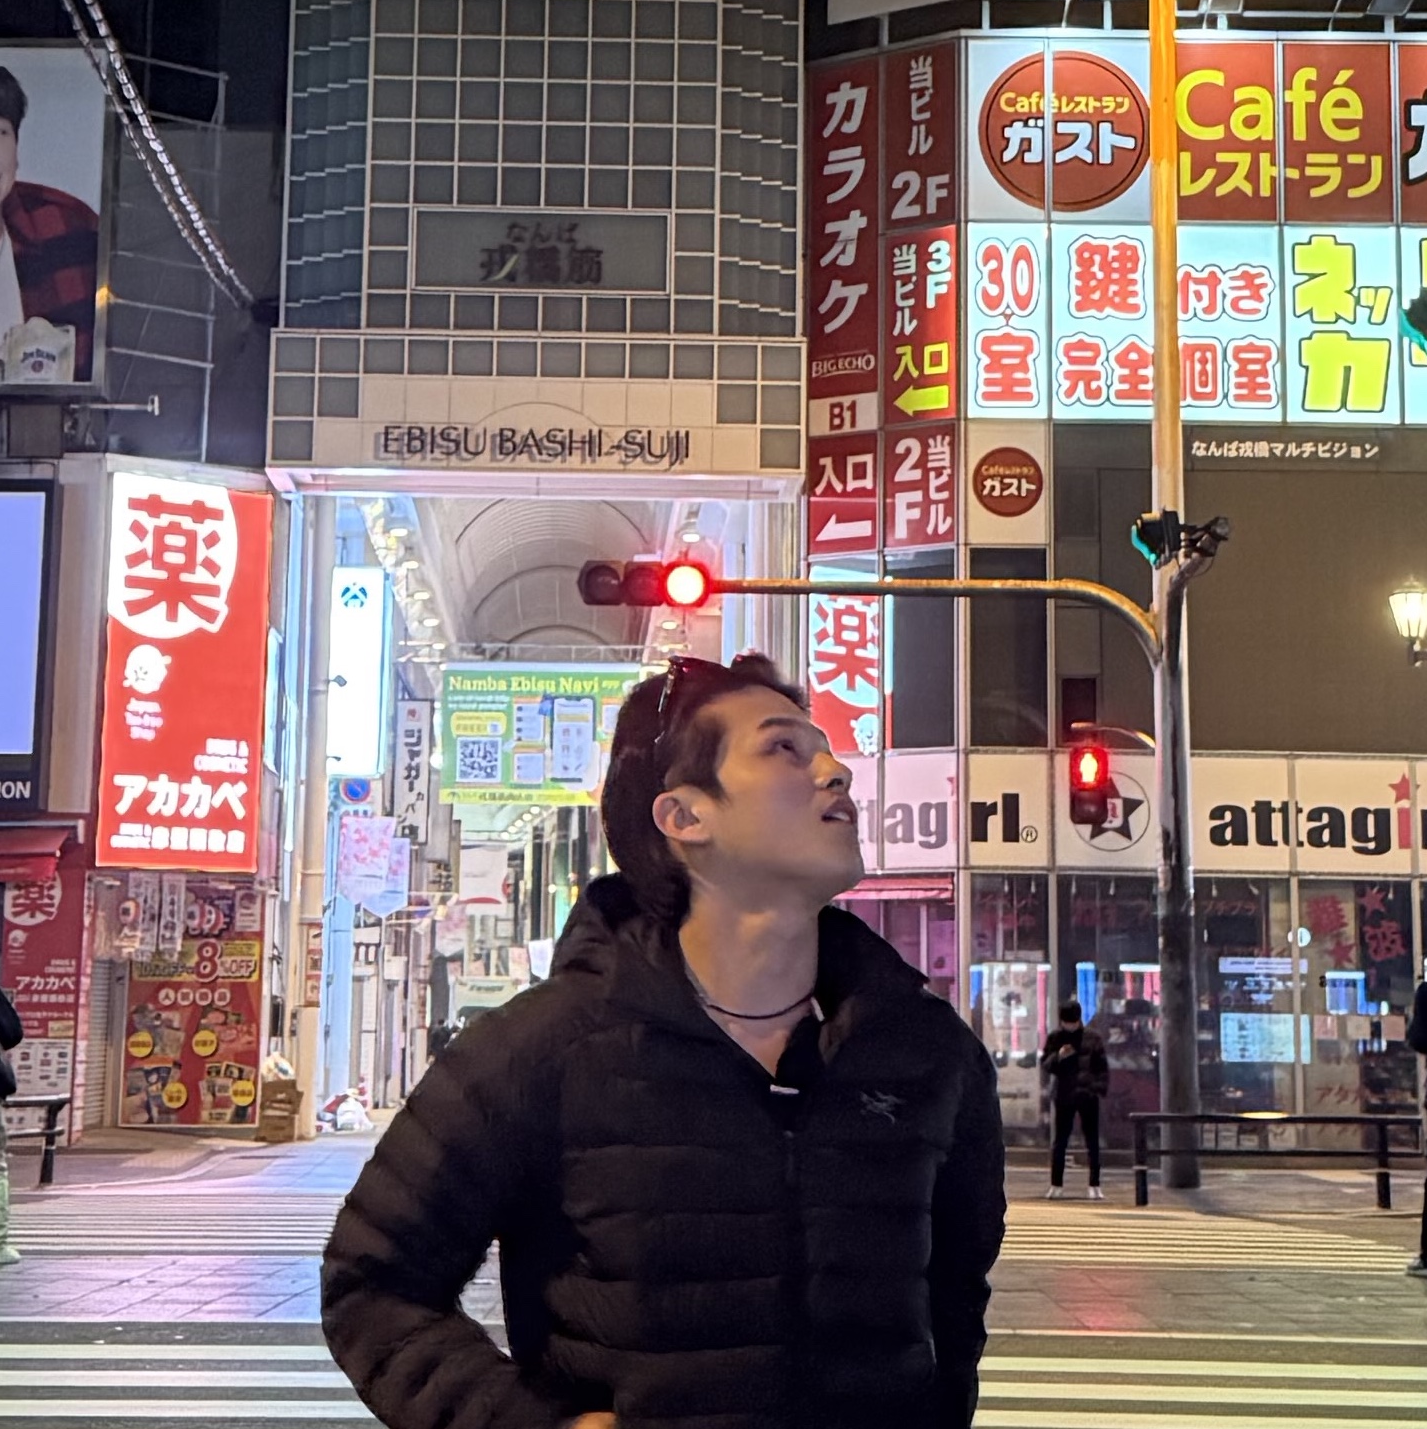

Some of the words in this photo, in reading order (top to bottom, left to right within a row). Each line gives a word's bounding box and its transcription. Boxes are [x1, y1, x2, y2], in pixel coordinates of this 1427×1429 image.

[909, 55, 934, 156] 当ビル
[1174, 67, 1365, 141] Café
[1002, 117, 1137, 165] ガスト
[891, 171, 950, 220] 2F
[1179, 152, 1383, 199] レストラン
[818, 81, 869, 334] カラオケ
[892, 245, 917, 336] 当ビル
[981, 243, 1034, 313] 30
[893, 341, 950, 382] 入口
[828, 400, 857, 432] B1
[383, 425, 488, 456] EBISU
[815, 453, 874, 496] 入口
[926, 434, 953, 535] 当ビル
[982, 476, 1037, 497] ガスト
[123, 493, 224, 624] 薬
[113, 773, 248, 820] アカカベ
[15, 974, 76, 991] アカカベ
